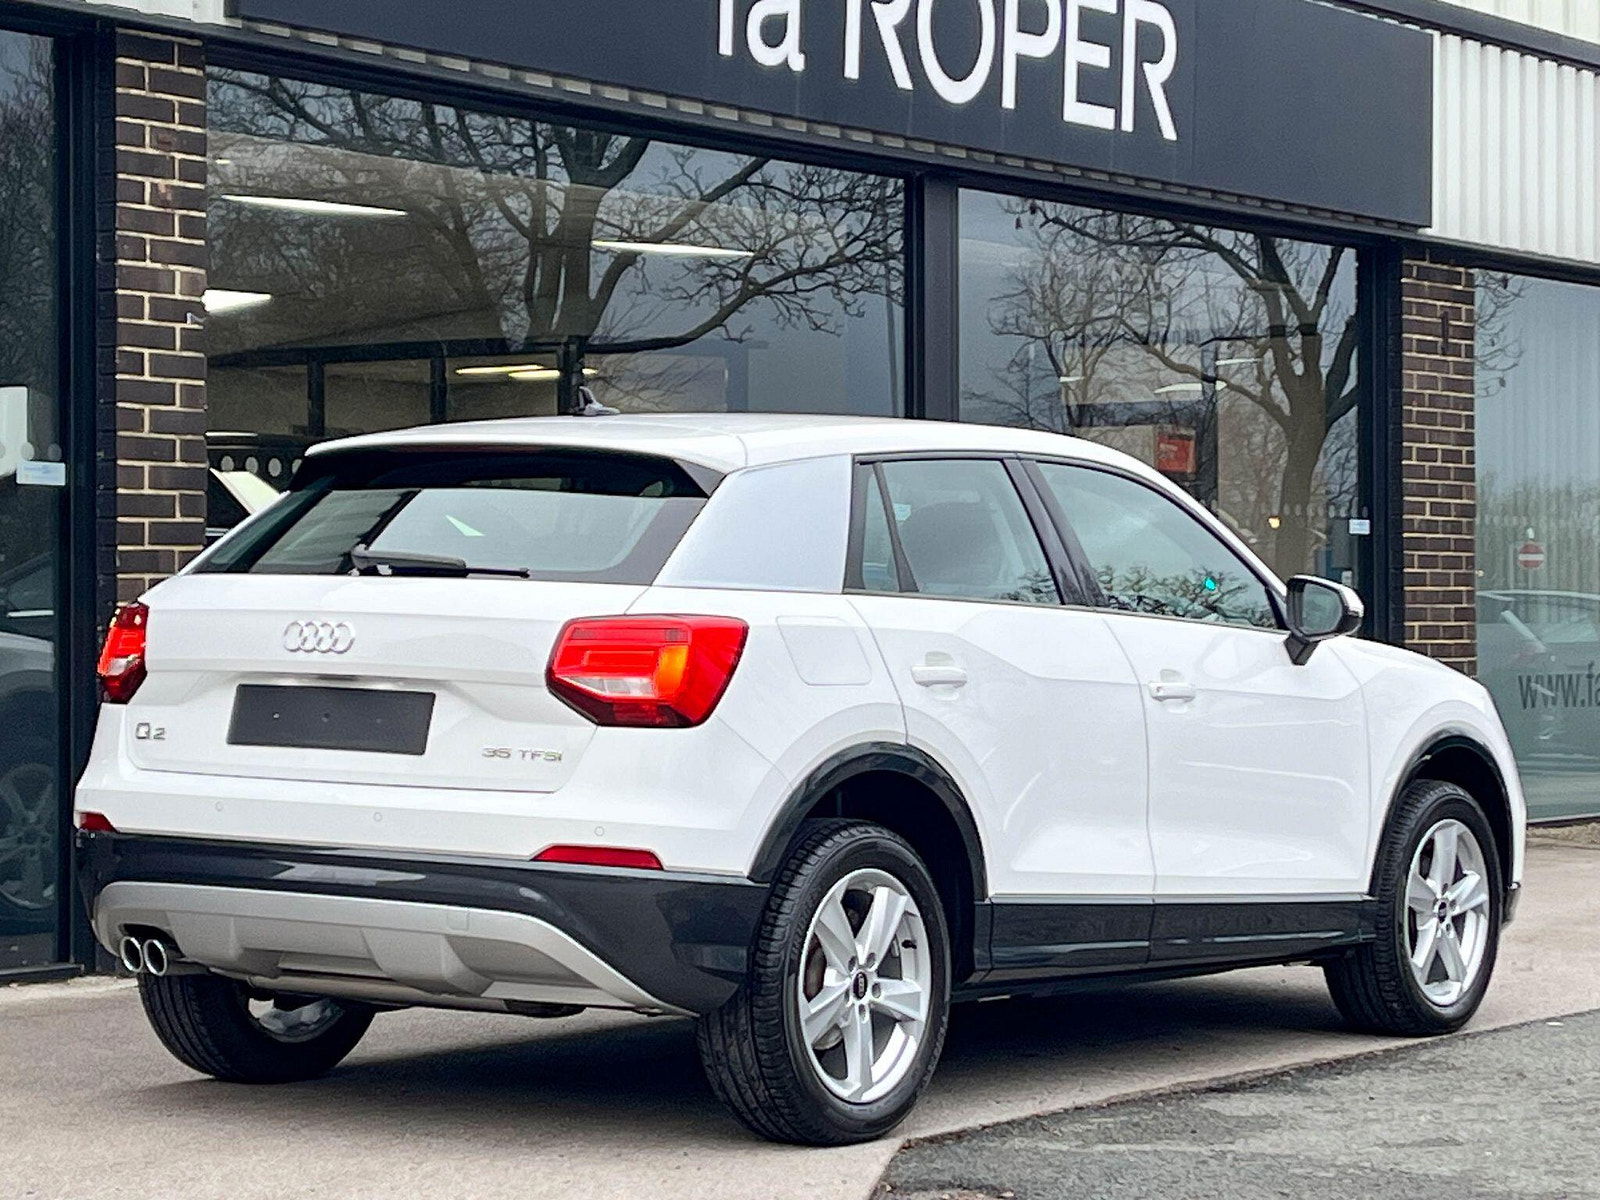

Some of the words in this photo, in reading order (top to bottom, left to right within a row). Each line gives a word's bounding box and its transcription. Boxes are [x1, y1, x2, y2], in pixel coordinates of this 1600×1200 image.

[843, 0, 1178, 141] ROPER
[135, 722, 166, 740] Q2
[481, 746, 512, 759] 35
